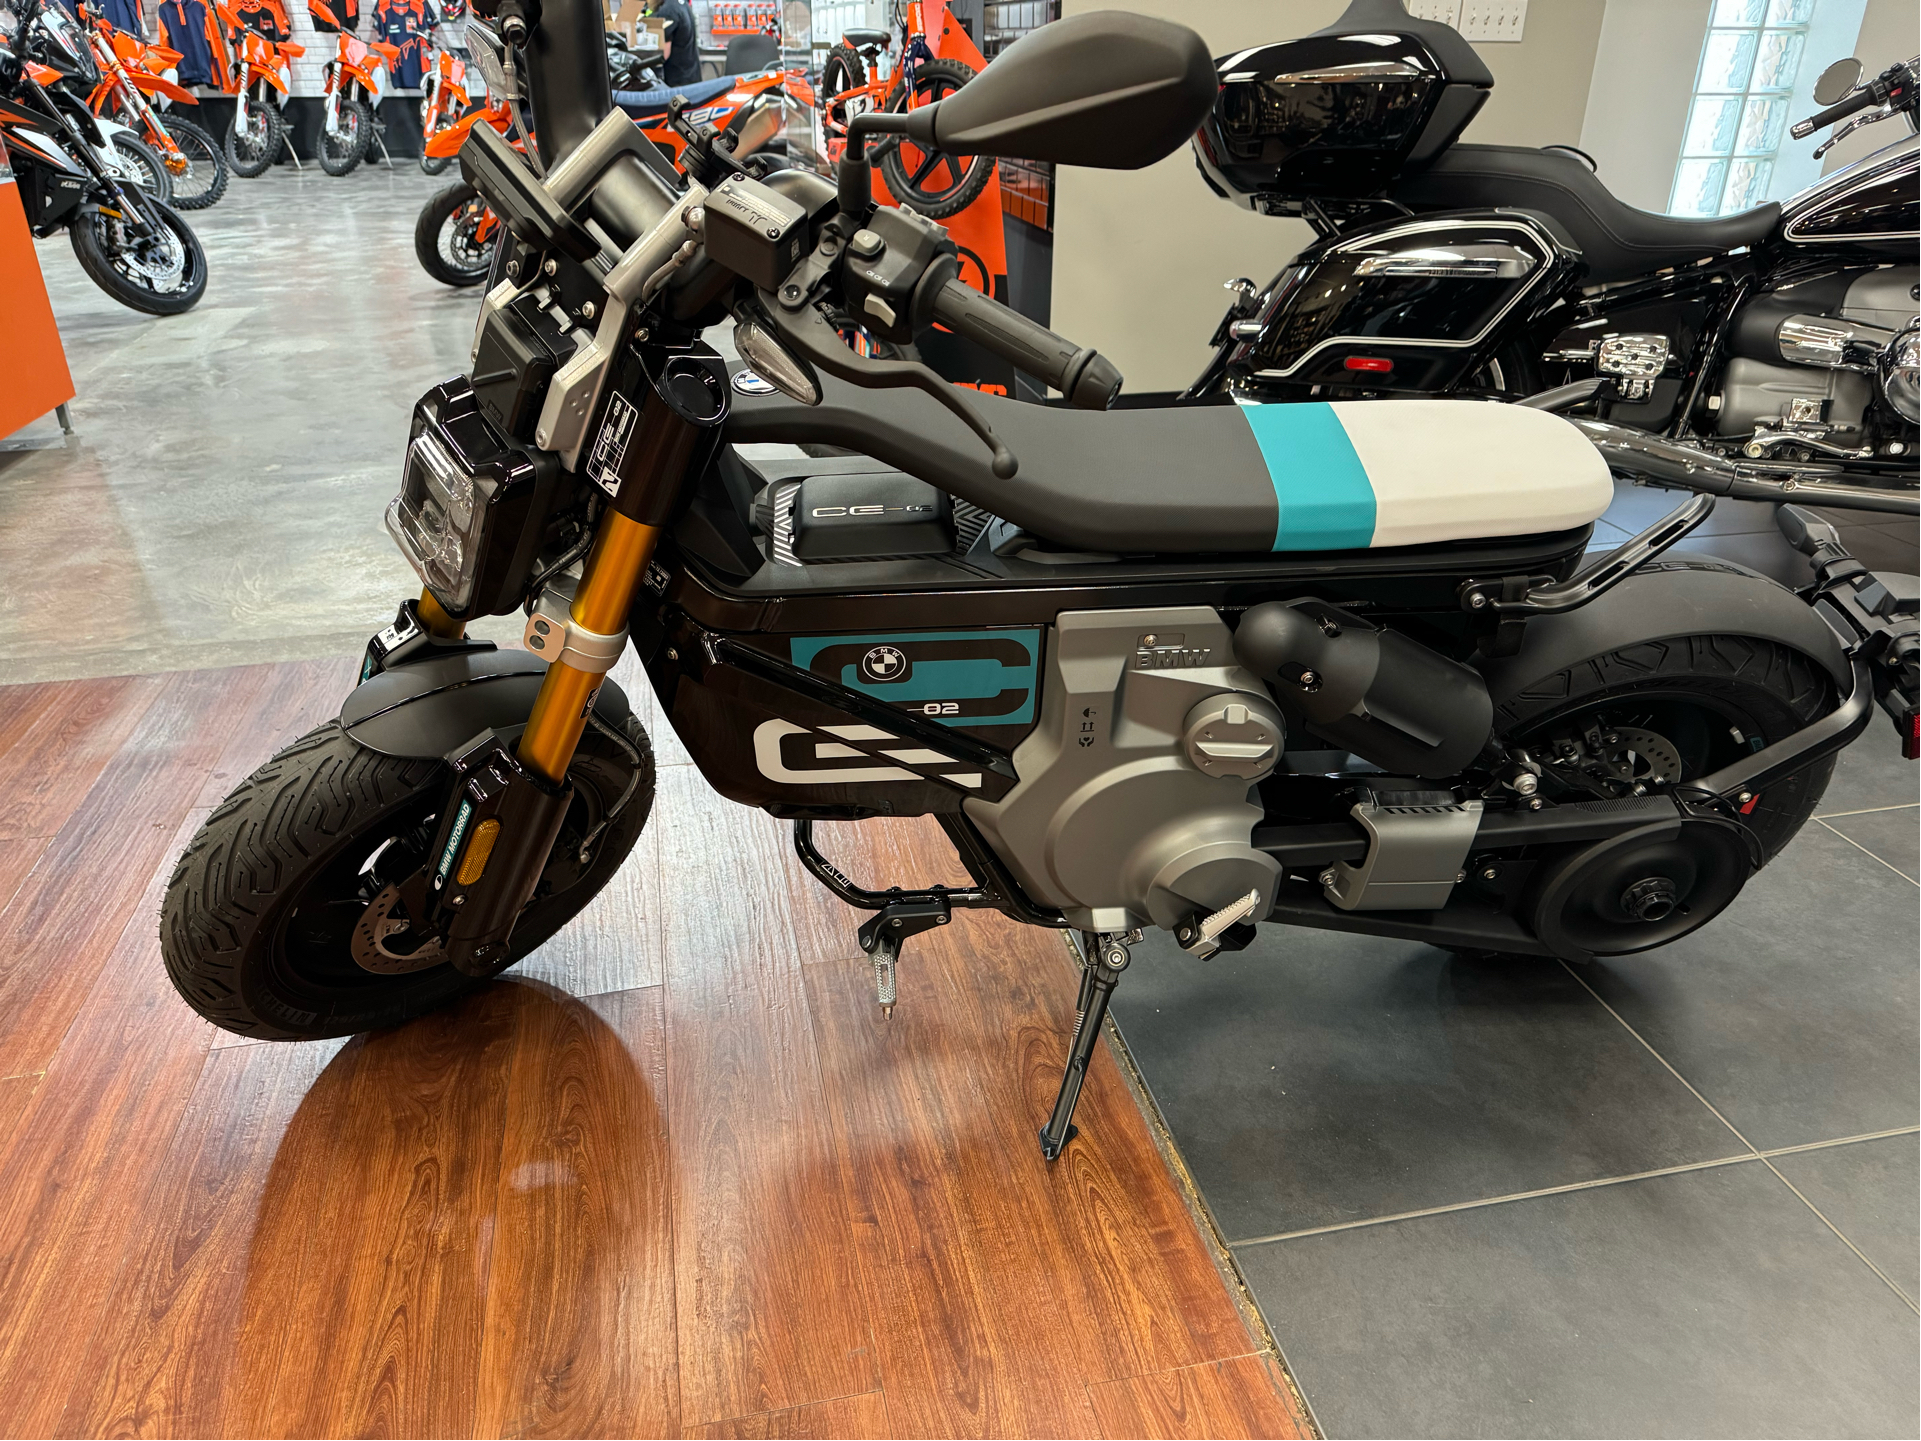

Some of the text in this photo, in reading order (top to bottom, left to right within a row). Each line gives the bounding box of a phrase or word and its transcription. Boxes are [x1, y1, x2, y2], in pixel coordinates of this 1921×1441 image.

[868, 648, 900, 659] BMW
[1135, 648, 1211, 669] BMW
[440, 804, 470, 876] BMW MOTORRAD
